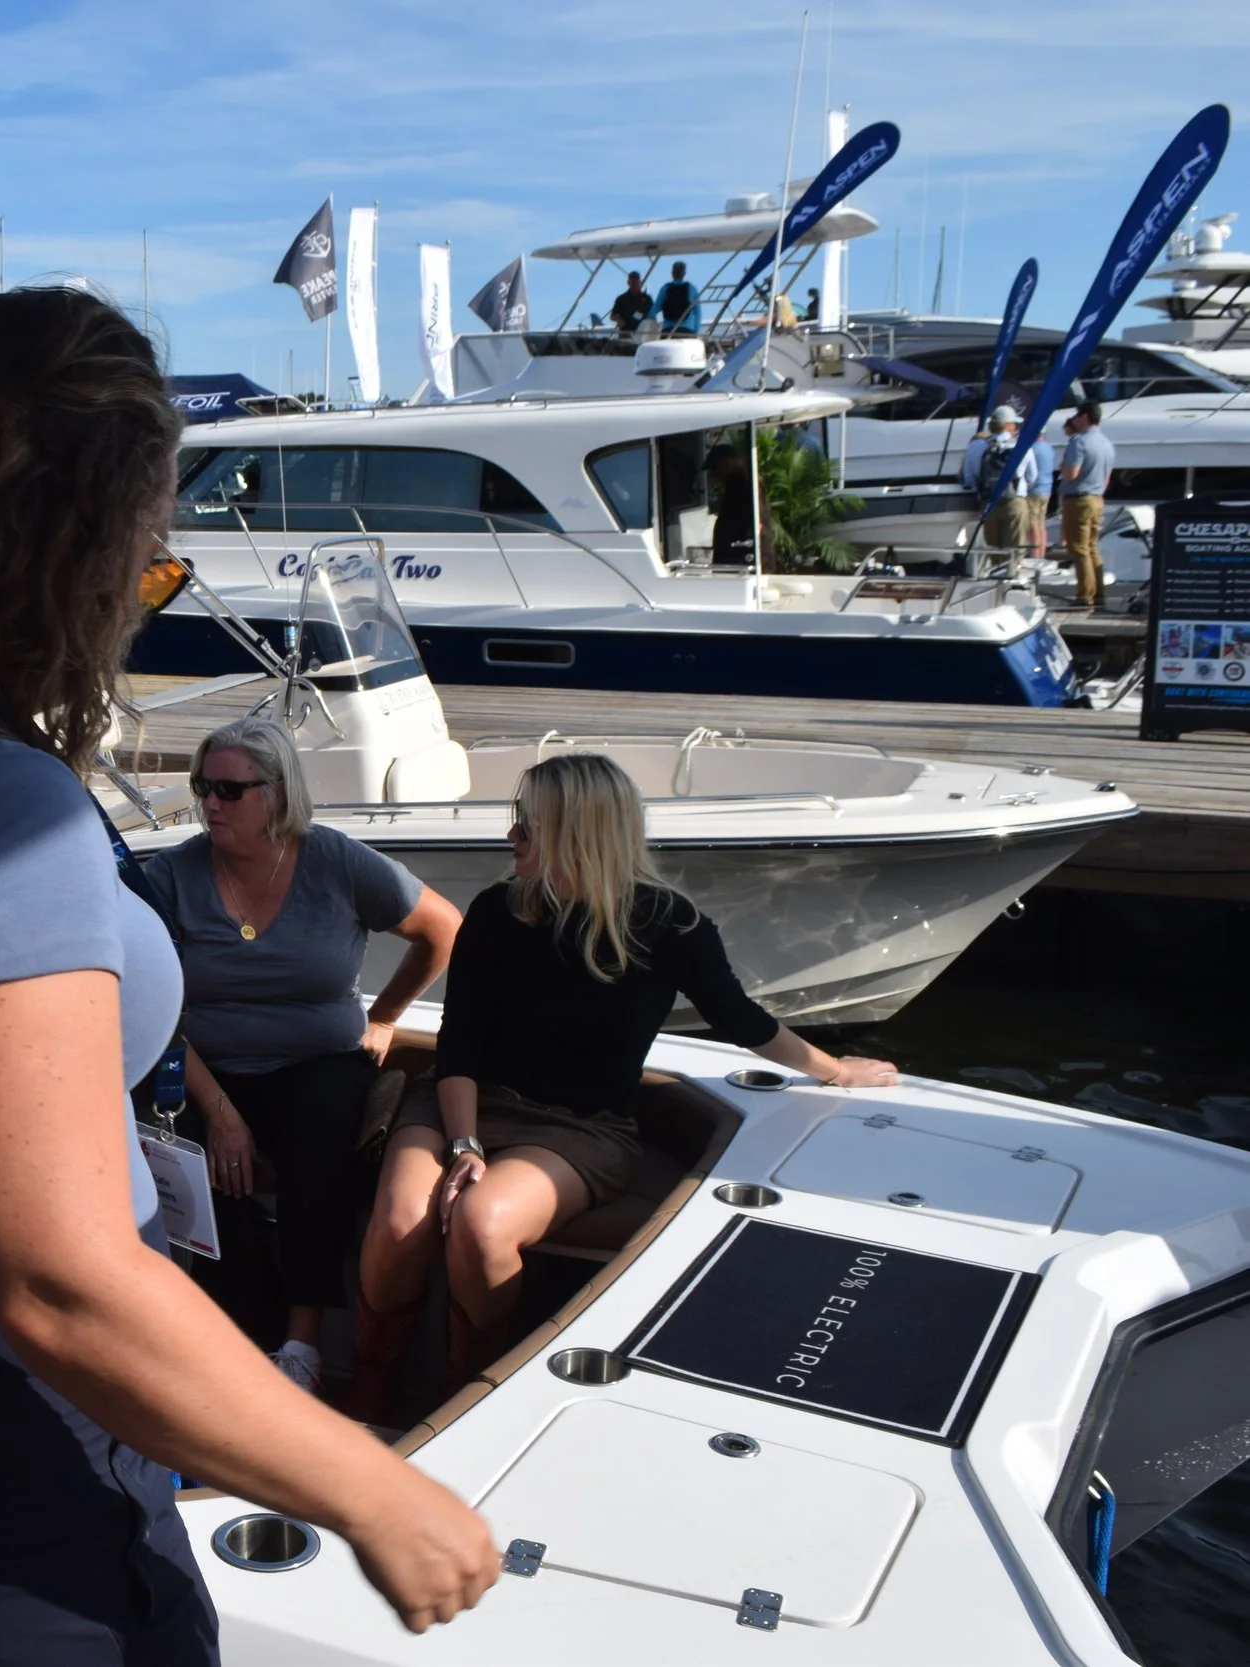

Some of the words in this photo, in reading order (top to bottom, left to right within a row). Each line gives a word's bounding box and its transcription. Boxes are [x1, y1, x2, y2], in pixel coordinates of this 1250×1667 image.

[823, 138, 887, 202] ASPEN
[1109, 141, 1209, 298] ASPEN
[1174, 523, 1250, 536] CHESAP
[392, 555, 442, 579] Two
[840, 1250, 888, 1290] 100%
[776, 1295, 857, 1388] ELECTRIC
